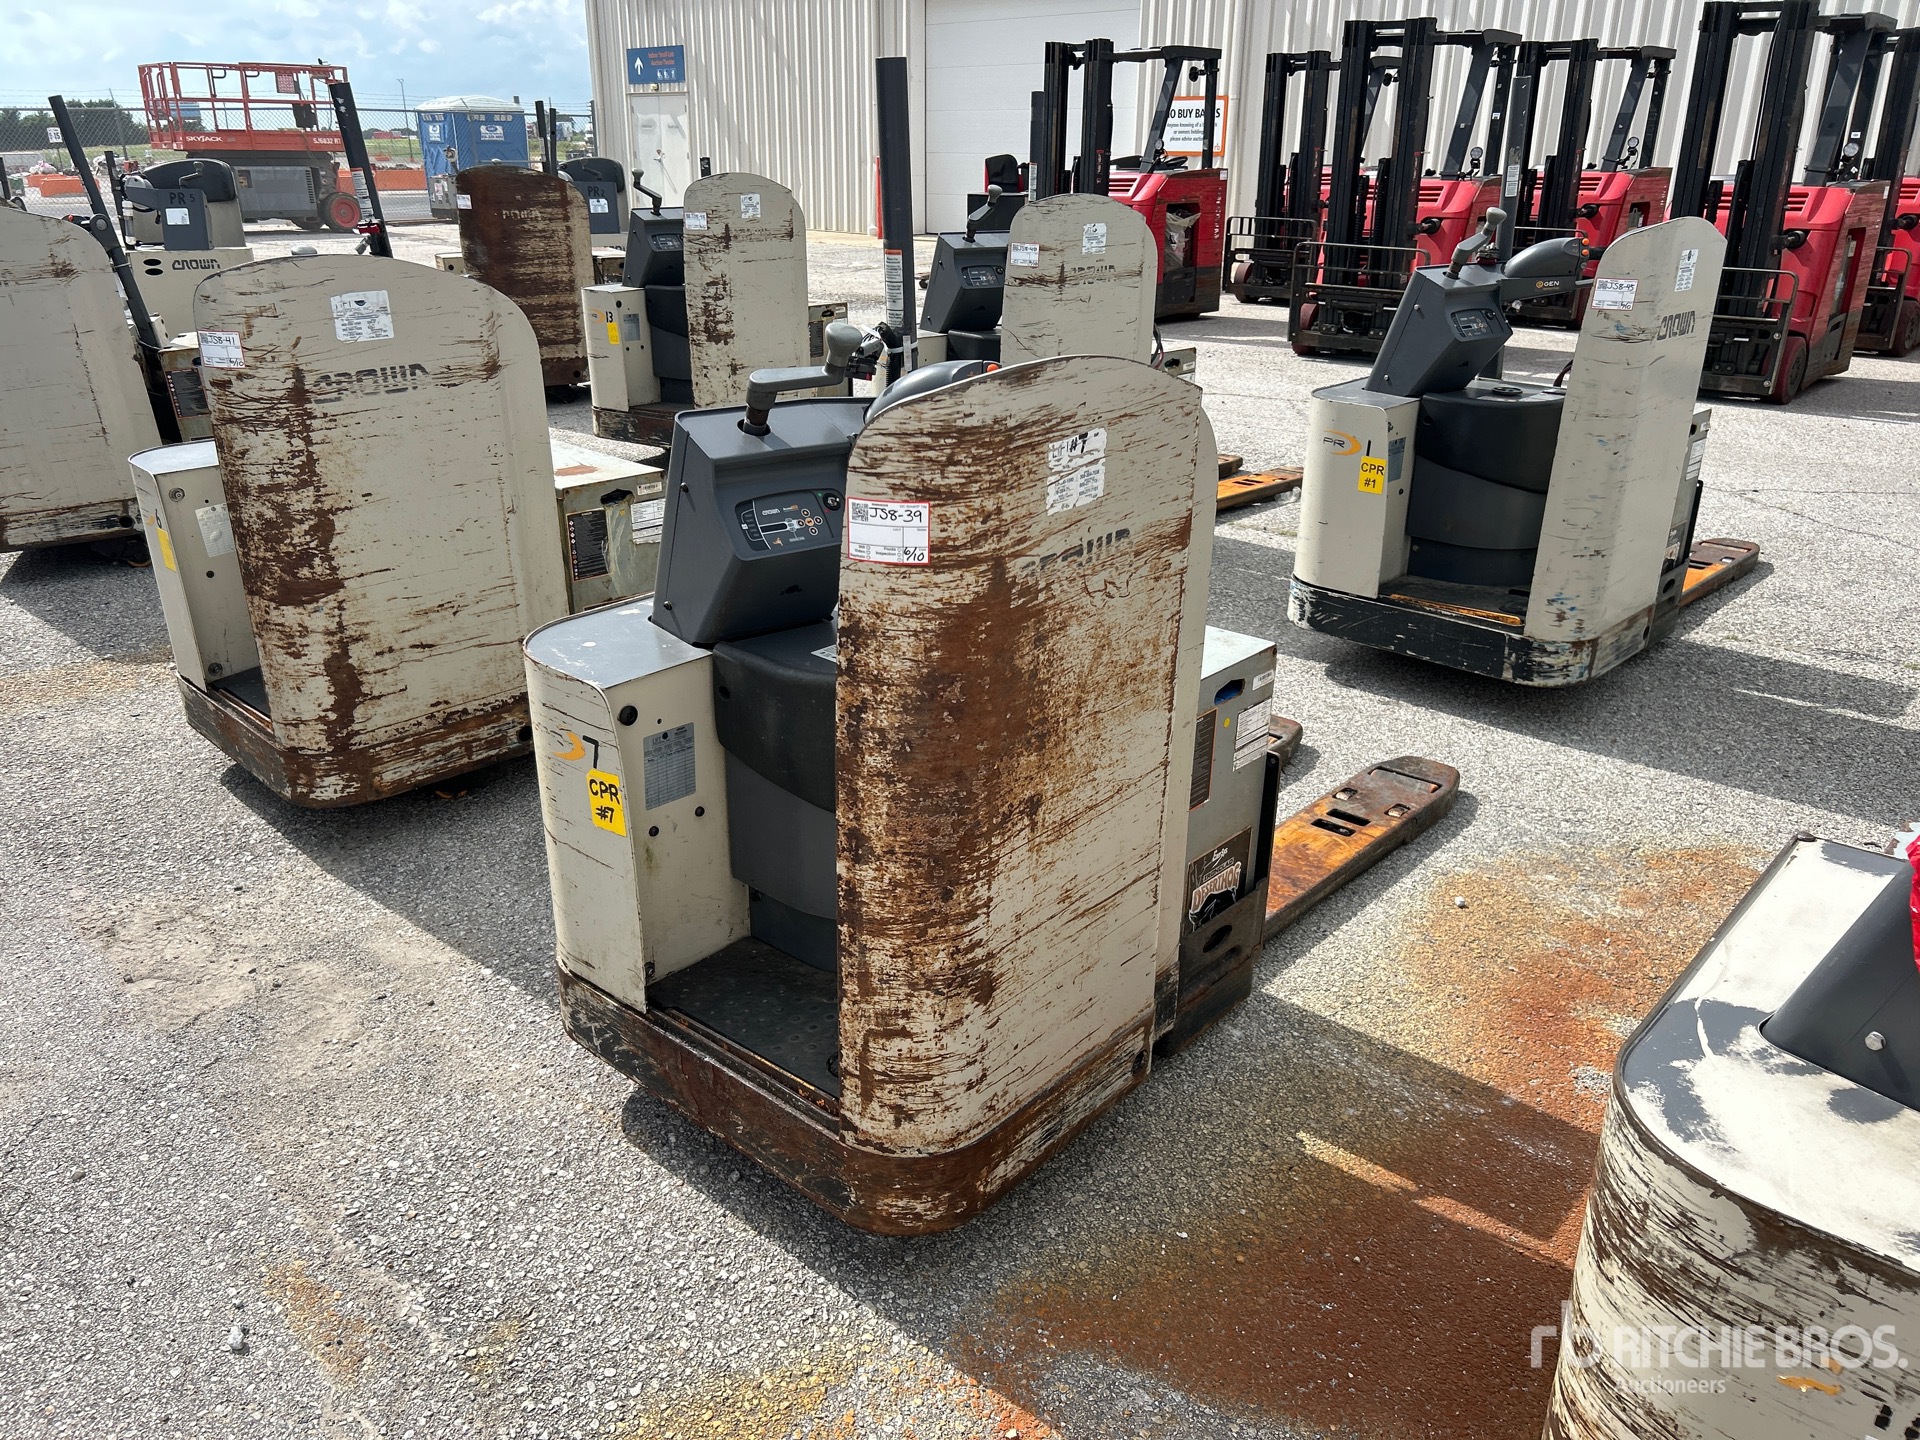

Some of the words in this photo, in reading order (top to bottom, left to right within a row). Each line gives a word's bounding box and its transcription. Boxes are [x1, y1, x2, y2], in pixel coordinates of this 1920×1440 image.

[1177, 108, 1193, 119] BUY
[1195, 107, 1221, 119] BAS
[186, 135, 223, 143] SKYJACK
[587, 185, 600, 197] PR
[600, 189, 606, 198] 2
[169, 192, 186, 205] PR
[189, 193, 196, 203] 5
[172, 258, 221, 270] CROWN
[605, 310, 614, 324] 13
[1657, 310, 1696, 341] CROWN
[1322, 436, 1346, 448] PR
[1360, 462, 1385, 476] CPR
[1363, 477, 1376, 489] #1
[903, 546, 925, 562] 6/10
[589, 778, 621, 806] CPR
[595, 805, 615, 824] #7
